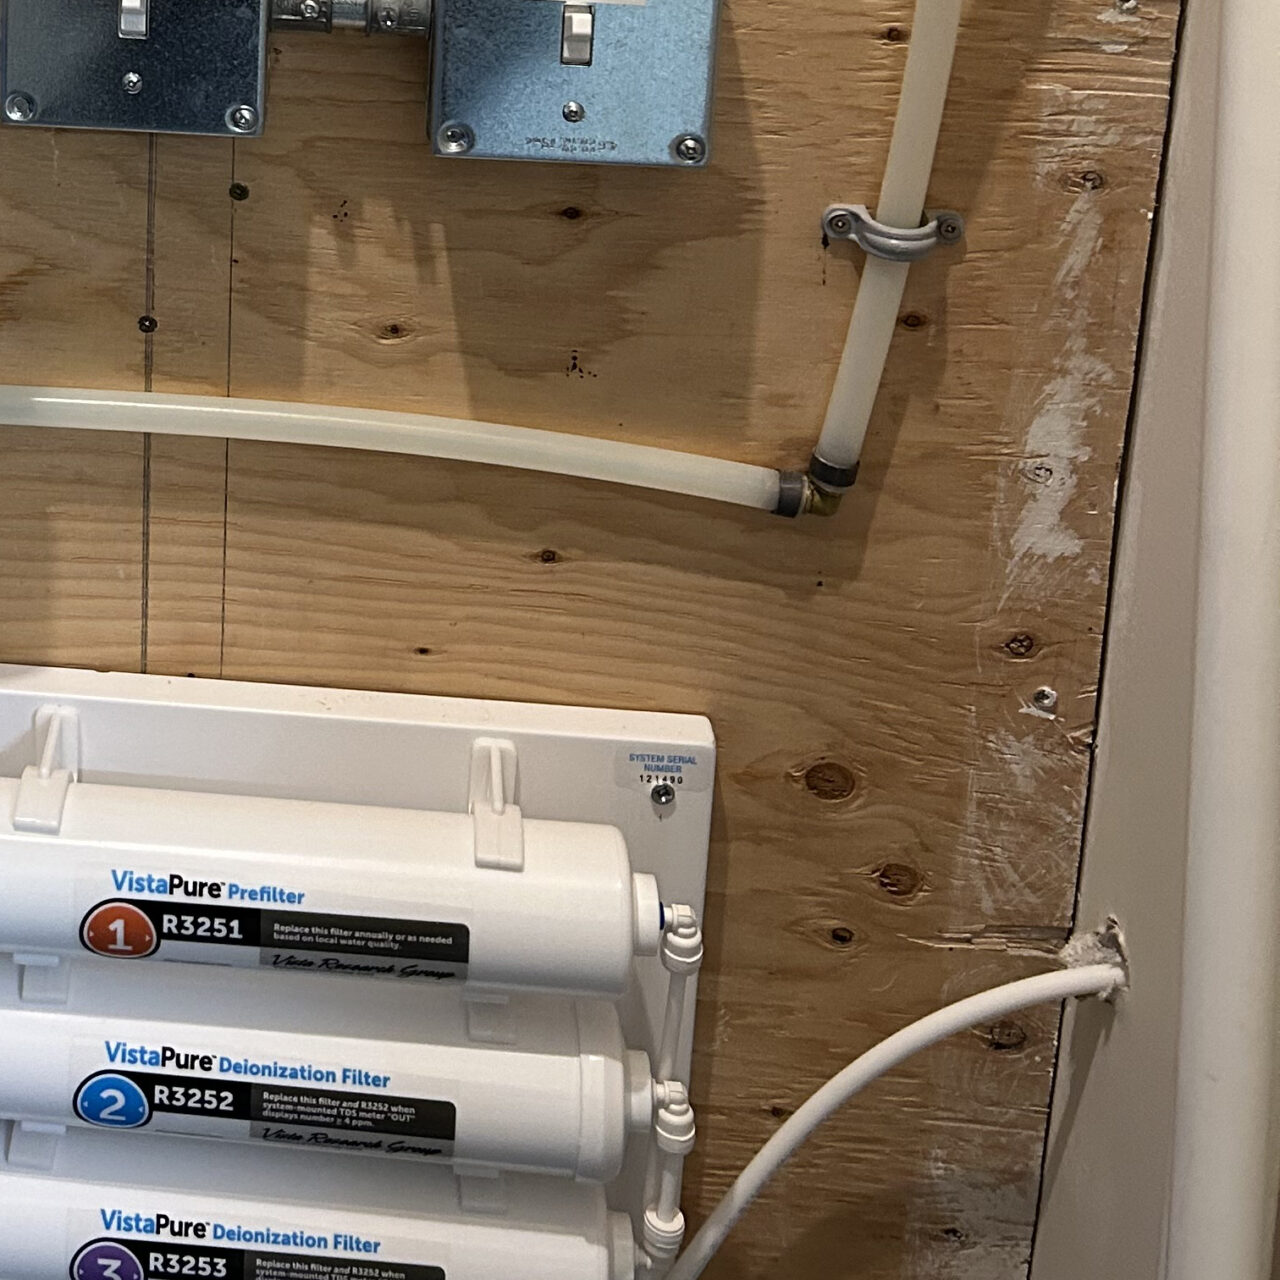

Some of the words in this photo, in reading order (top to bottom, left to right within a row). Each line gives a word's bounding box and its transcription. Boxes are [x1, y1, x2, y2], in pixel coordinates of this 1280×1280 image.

[629, 753, 665, 762] SYSTEM
[666, 755, 697, 765] SERIAL
[644, 763, 682, 773] NUMBER
[228, 883, 305, 904] Prefilter
[107, 919, 133, 950] 1
[162, 914, 243, 939] R3251
[273, 931, 300, 941] based
[340, 937, 365, 947] water
[274, 923, 310, 934] Replace
[311, 925, 328, 935] this
[330, 927, 353, 937] filter
[354, 930, 393, 941] annually
[419, 934, 453, 945] needed
[219, 1056, 337, 1084] Deionization
[342, 1067, 391, 1088] Filter
[99, 1089, 126, 1120] 2
[154, 1085, 234, 1111] R3252
[263, 1092, 298, 1103] Replace
[300, 1095, 317, 1104] this
[319, 1096, 340, 1107] filter
[342, 1099, 359, 1109] and
[390, 1104, 416, 1114] when
[339, 1108, 357, 1117] TDS
[359, 1111, 385, 1120] meter
[213, 1223, 328, 1249] Deionization
[333, 1234, 381, 1254] Filter
[97, 1258, 122, 1280] 3
[149, 1252, 227, 1277] R3253
[256, 1258, 290, 1269] Replace
[292, 1262, 309, 1270] this
[334, 1265, 351, 1275] and
[381, 1269, 406, 1280] when
